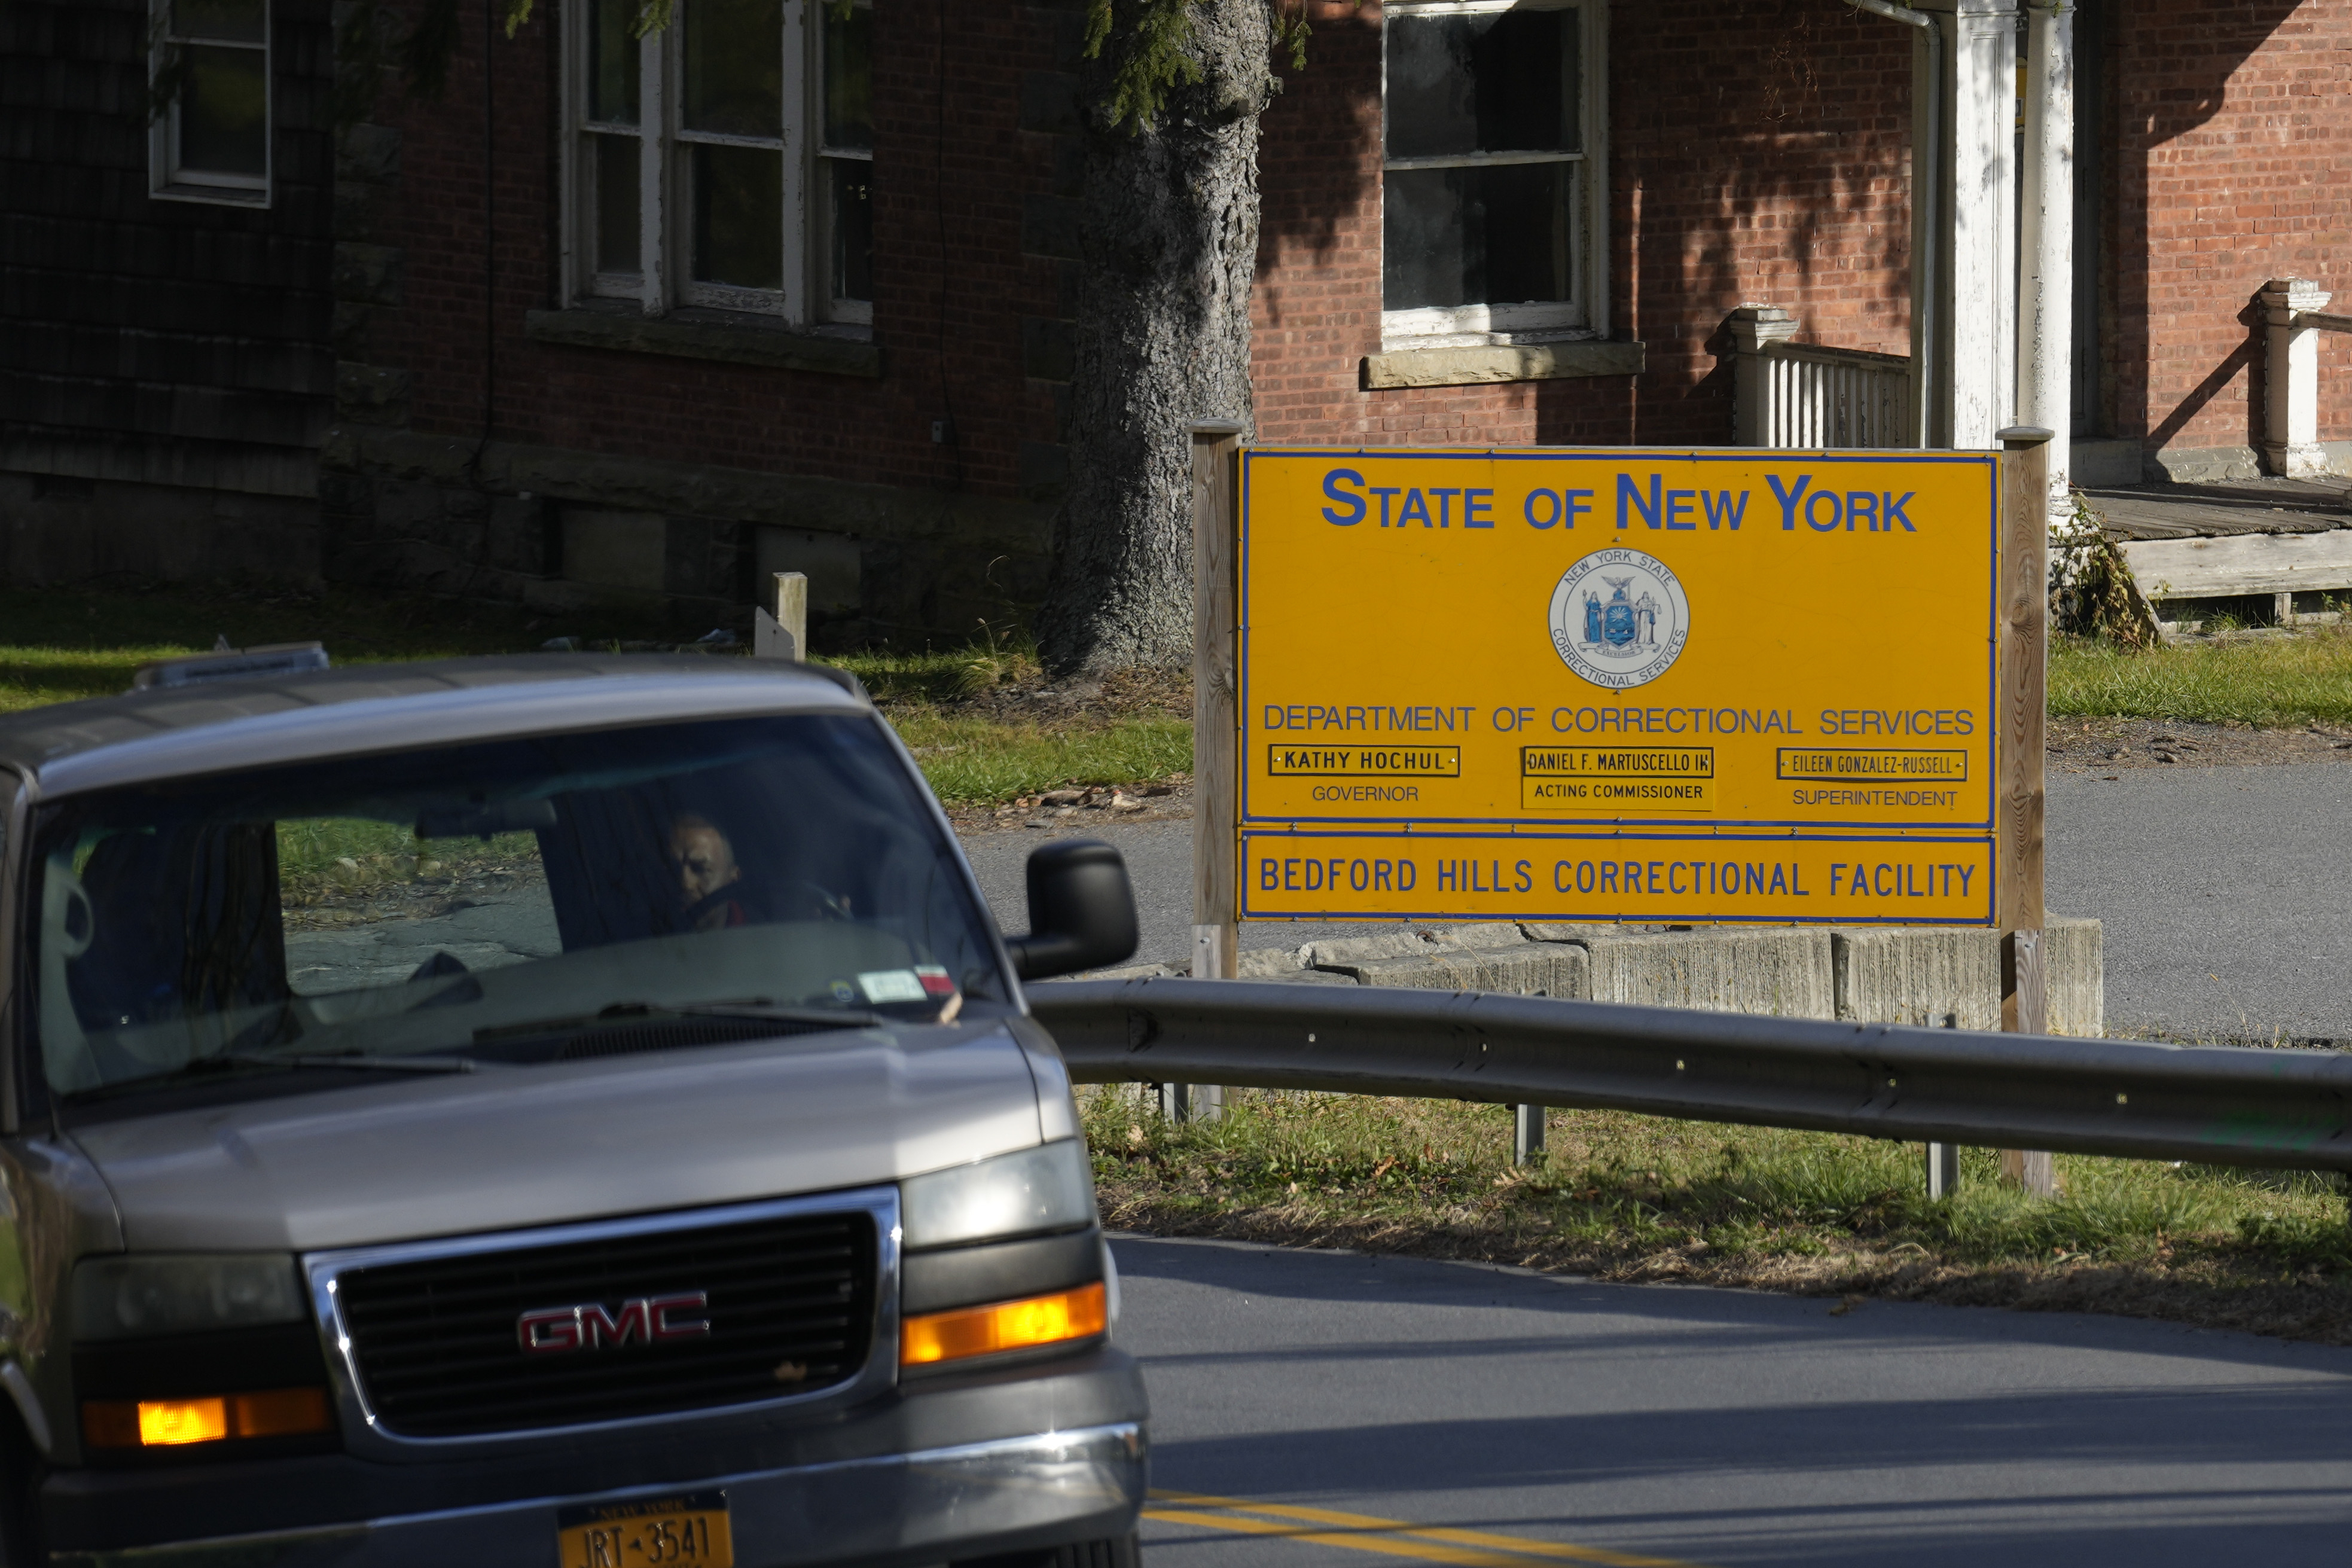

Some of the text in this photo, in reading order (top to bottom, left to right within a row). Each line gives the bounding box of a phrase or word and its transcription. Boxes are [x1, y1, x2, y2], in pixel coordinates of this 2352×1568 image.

[1322, 468, 1917, 533] STATE OF NEW YORK
[1564, 551, 1675, 587] NEW YORK STATE
[1553, 628, 1685, 687] CORRECTIONAL SERVICES
[1264, 705, 1975, 736] DEPARTMENT OF CORRECTIONAL SERVICES
[1285, 752, 1445, 770] KATHY HOCHUL
[1529, 754, 1576, 770] DANIEL
[1582, 754, 1592, 770] F.
[1598, 754, 1690, 771] MARTUSCELLO
[1793, 755, 1953, 774] EILEEN GONZALEZ-RUSSELL
[1313, 786, 1418, 802] GOVERNOR
[1535, 785, 1703, 798] ACTING COMMISSIONER
[1793, 789, 1959, 806] SUPERINTENDENT
[1261, 858, 1976, 897] BEDFORD HILLS CORRECTIONAL FACILITY
[519, 1290, 710, 1353] GMC
